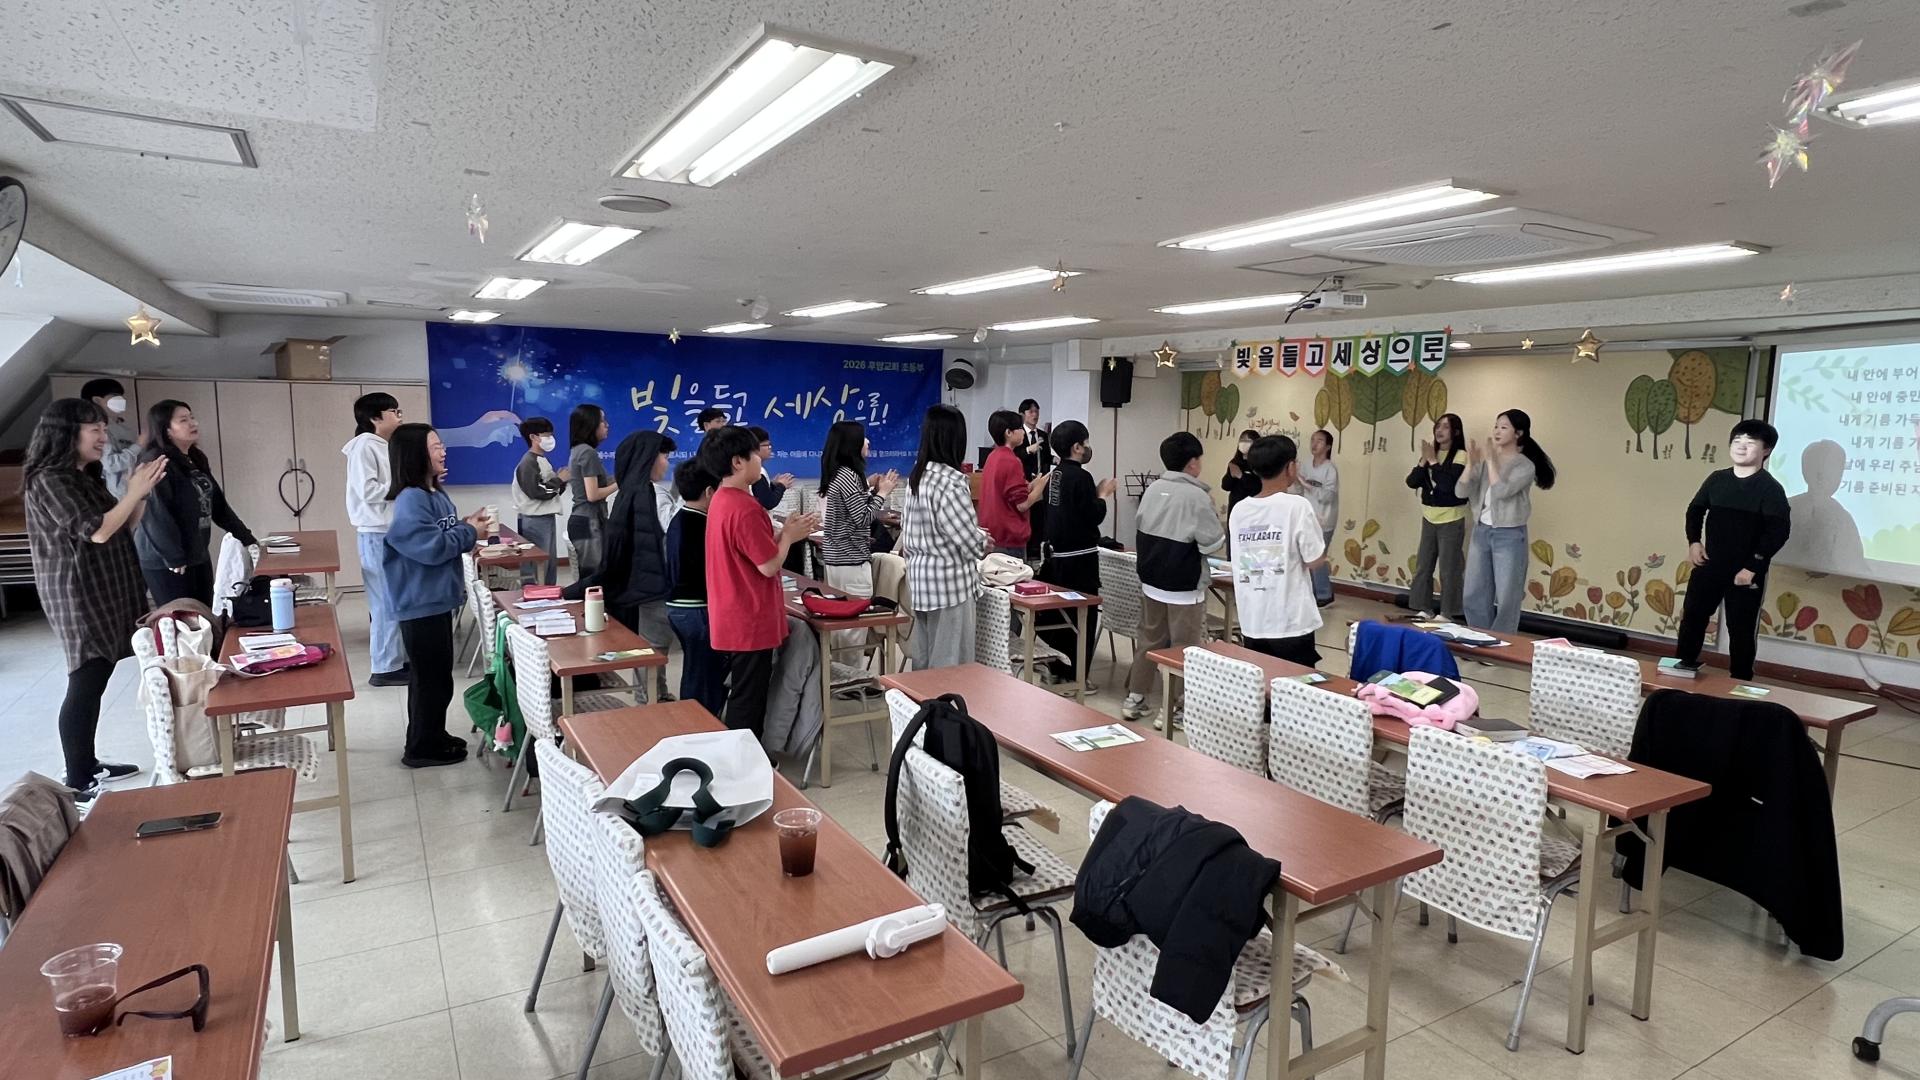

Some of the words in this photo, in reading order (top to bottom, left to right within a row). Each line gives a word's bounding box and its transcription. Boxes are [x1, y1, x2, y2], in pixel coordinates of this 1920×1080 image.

[843, 360, 866, 370] 2026
[1847, 369, 1858, 381] 내
[1863, 368, 1888, 381] 안에
[1893, 366, 1919, 381] 부어
[1851, 391, 1862, 404] 내
[1867, 391, 1892, 403] 안에
[1840, 413, 1861, 427] 내게
[1865, 413, 1890, 426] 기름
[1851, 436, 1875, 448] 내게
[1879, 437, 1904, 449] 기름
[1869, 460, 1894, 472] 우리
[1869, 482, 1906, 496] 준비된
